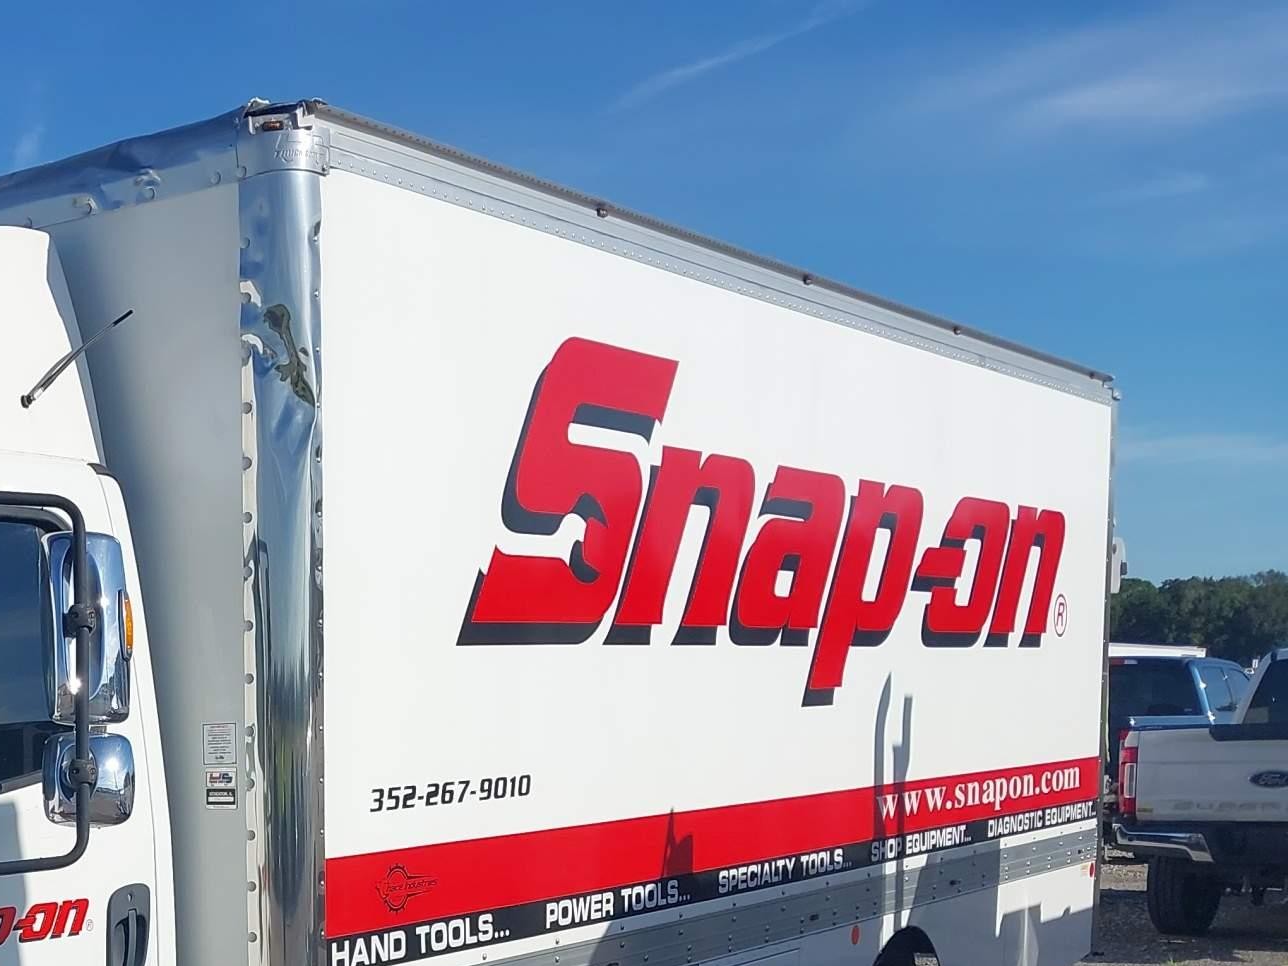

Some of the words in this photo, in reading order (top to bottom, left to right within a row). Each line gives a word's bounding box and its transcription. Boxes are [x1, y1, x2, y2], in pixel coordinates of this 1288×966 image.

[456, 336, 1066, 707] Snap-on
[369, 774, 532, 813] 352-267-9010
[876, 766, 1081, 821] www.snapon.com
[416, 913, 510, 954] TOOLS...
[545, 891, 614, 929] POWER
[621, 879, 691, 912] TOOLS...
[718, 857, 796, 894] SPECIALTY
[870, 837, 902, 863] SHOP
[987, 809, 1043, 838] DIAGNOSTIC
